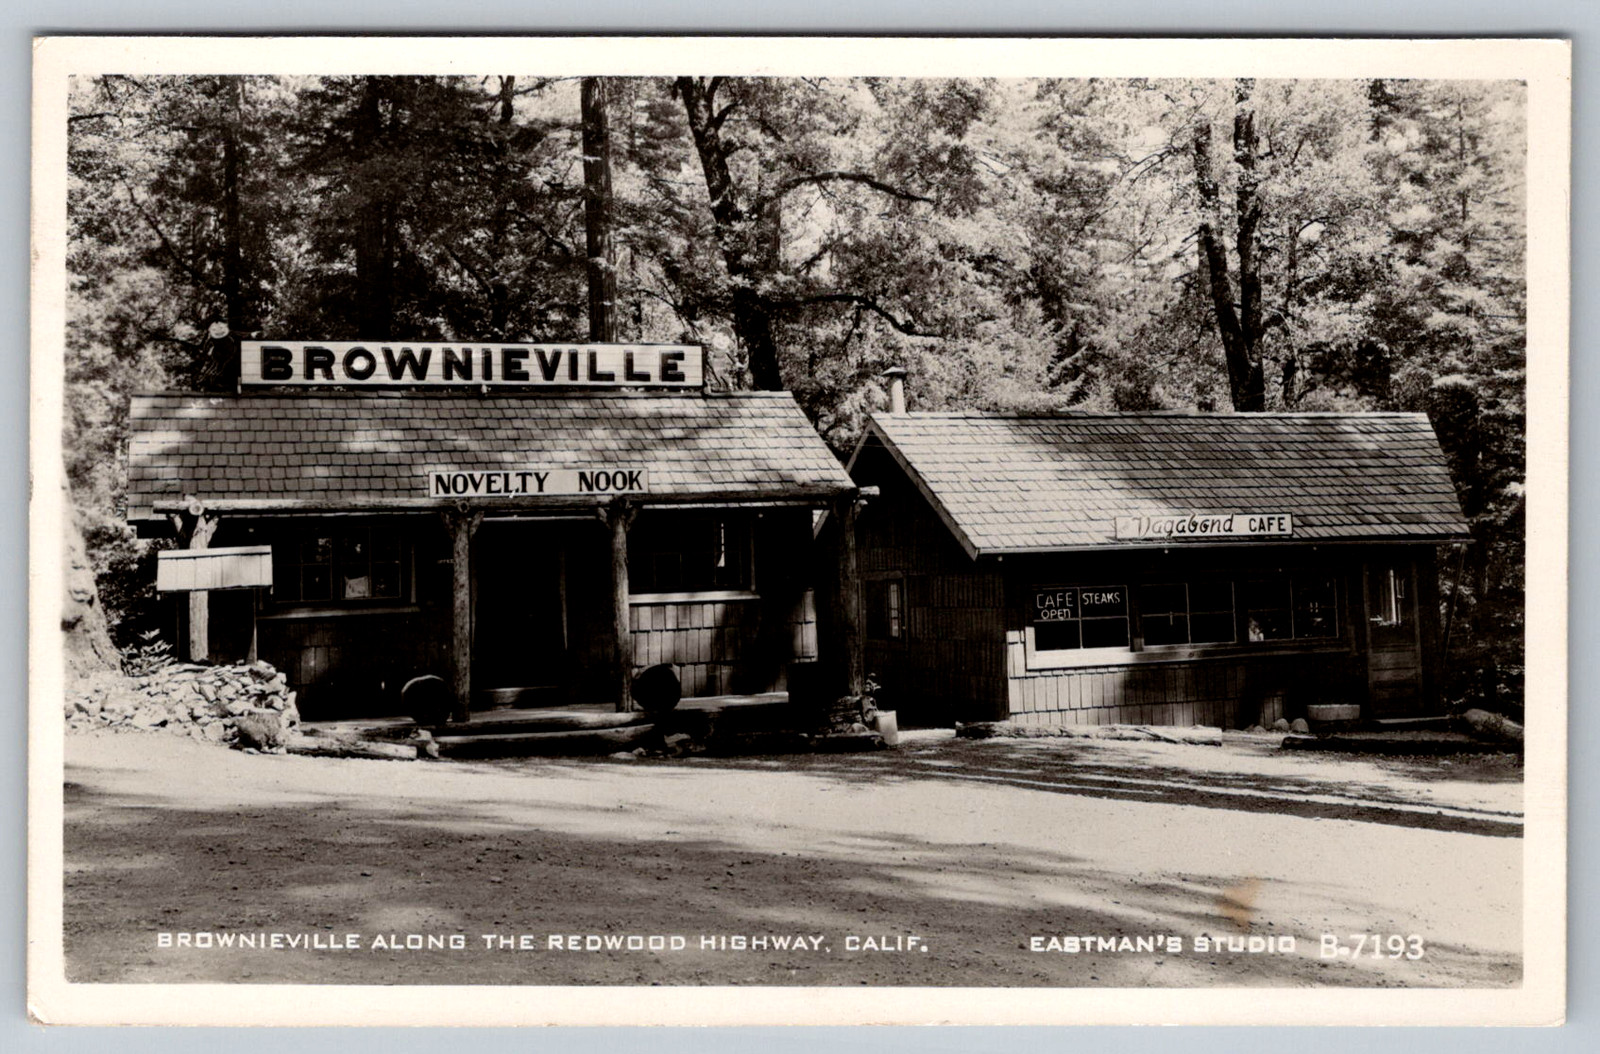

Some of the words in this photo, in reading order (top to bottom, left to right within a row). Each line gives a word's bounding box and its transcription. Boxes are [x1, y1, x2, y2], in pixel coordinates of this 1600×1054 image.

[259, 345, 686, 382] BROWNIEVILLE
[434, 472, 550, 495] NOVELTY
[578, 470, 643, 493] NOOK
[1131, 513, 1235, 537] Vagabond
[1248, 516, 1287, 533] CAFE
[1036, 592, 1074, 609] CAFE
[1081, 591, 1121, 606] STEAKS
